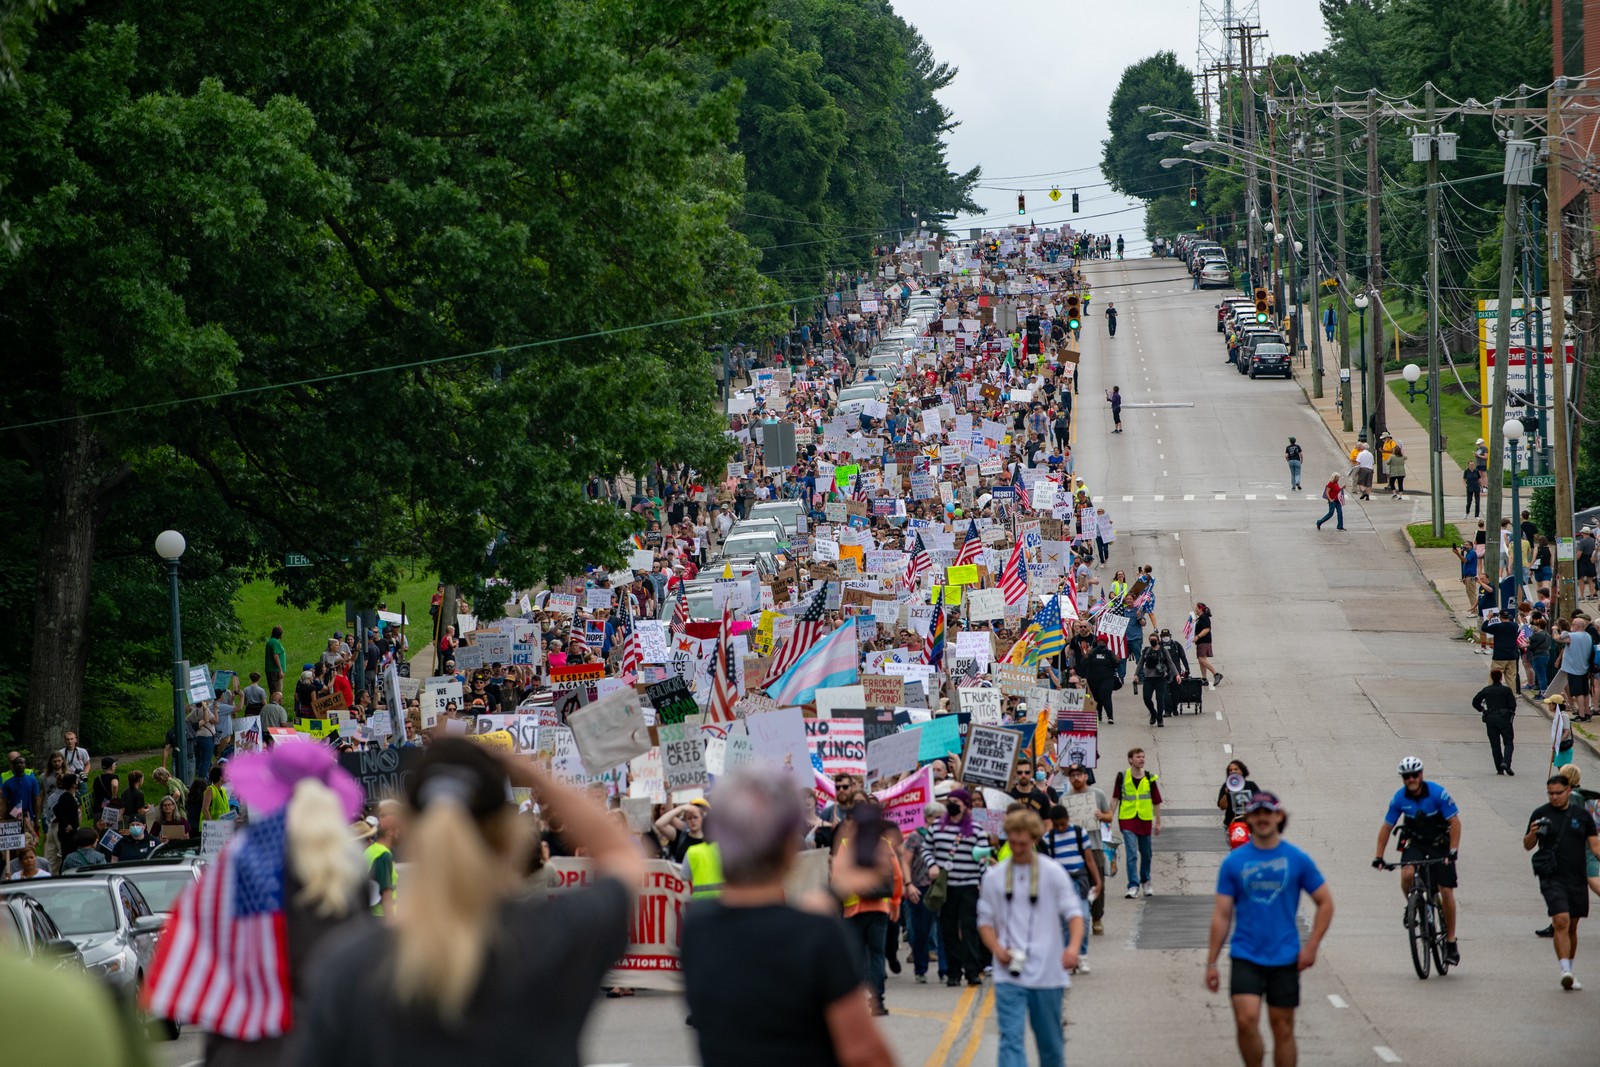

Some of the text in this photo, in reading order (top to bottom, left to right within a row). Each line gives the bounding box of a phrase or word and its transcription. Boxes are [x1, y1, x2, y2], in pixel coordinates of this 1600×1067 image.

[1522, 478, 1555, 486] TERRAC
[288, 555, 310, 564] TER
[513, 653, 532, 664] ICE
[672, 661, 685, 672] ICE
[554, 672, 600, 682] LESBIANS
[1002, 674, 1036, 683] ILLEGAL
[559, 679, 600, 689] AGAINS
[962, 692, 992, 703] TRUMP
[962, 705, 997, 718] TRITOR
[479, 718, 538, 750] RSIST
[805, 722, 829, 736] NO
[975, 729, 1014, 742] MONEY FOR
[667, 740, 703, 756] MEDI-
[973, 737, 1013, 752] PEOPLE'S
[668, 751, 700, 766] CAID
[977, 747, 1005, 759] NEEDS
[969, 756, 1008, 772] NOT THE
[668, 771, 708, 786] PARADE
[890, 791, 921, 807] BACK!
